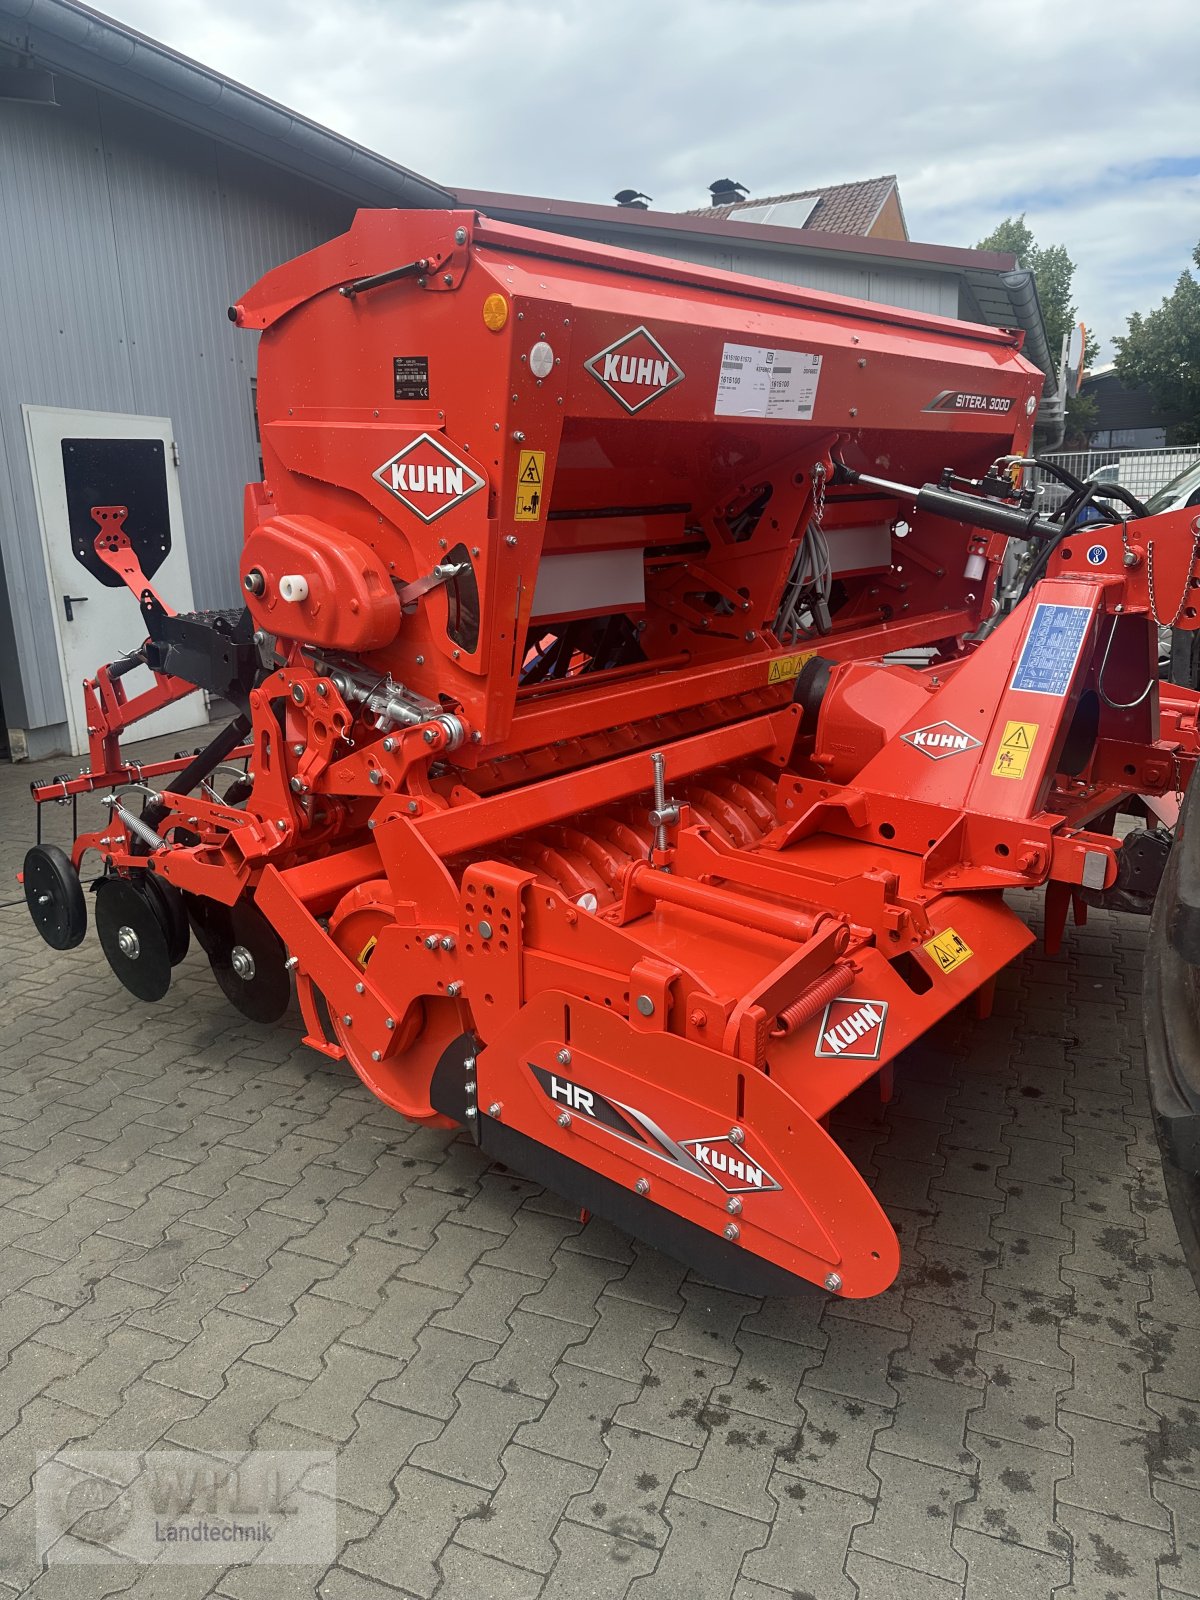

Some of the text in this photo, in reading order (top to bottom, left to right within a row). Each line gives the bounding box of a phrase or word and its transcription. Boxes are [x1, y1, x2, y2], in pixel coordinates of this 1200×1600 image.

[603, 353, 670, 387] KUHN
[955, 394, 1011, 411] SITERA 3000
[391, 463, 463, 495] KUHN
[913, 732, 969, 749] KUHN
[823, 1003, 882, 1054] KUHN
[551, 1075, 596, 1117] HR
[695, 1142, 763, 1188] KUHN
